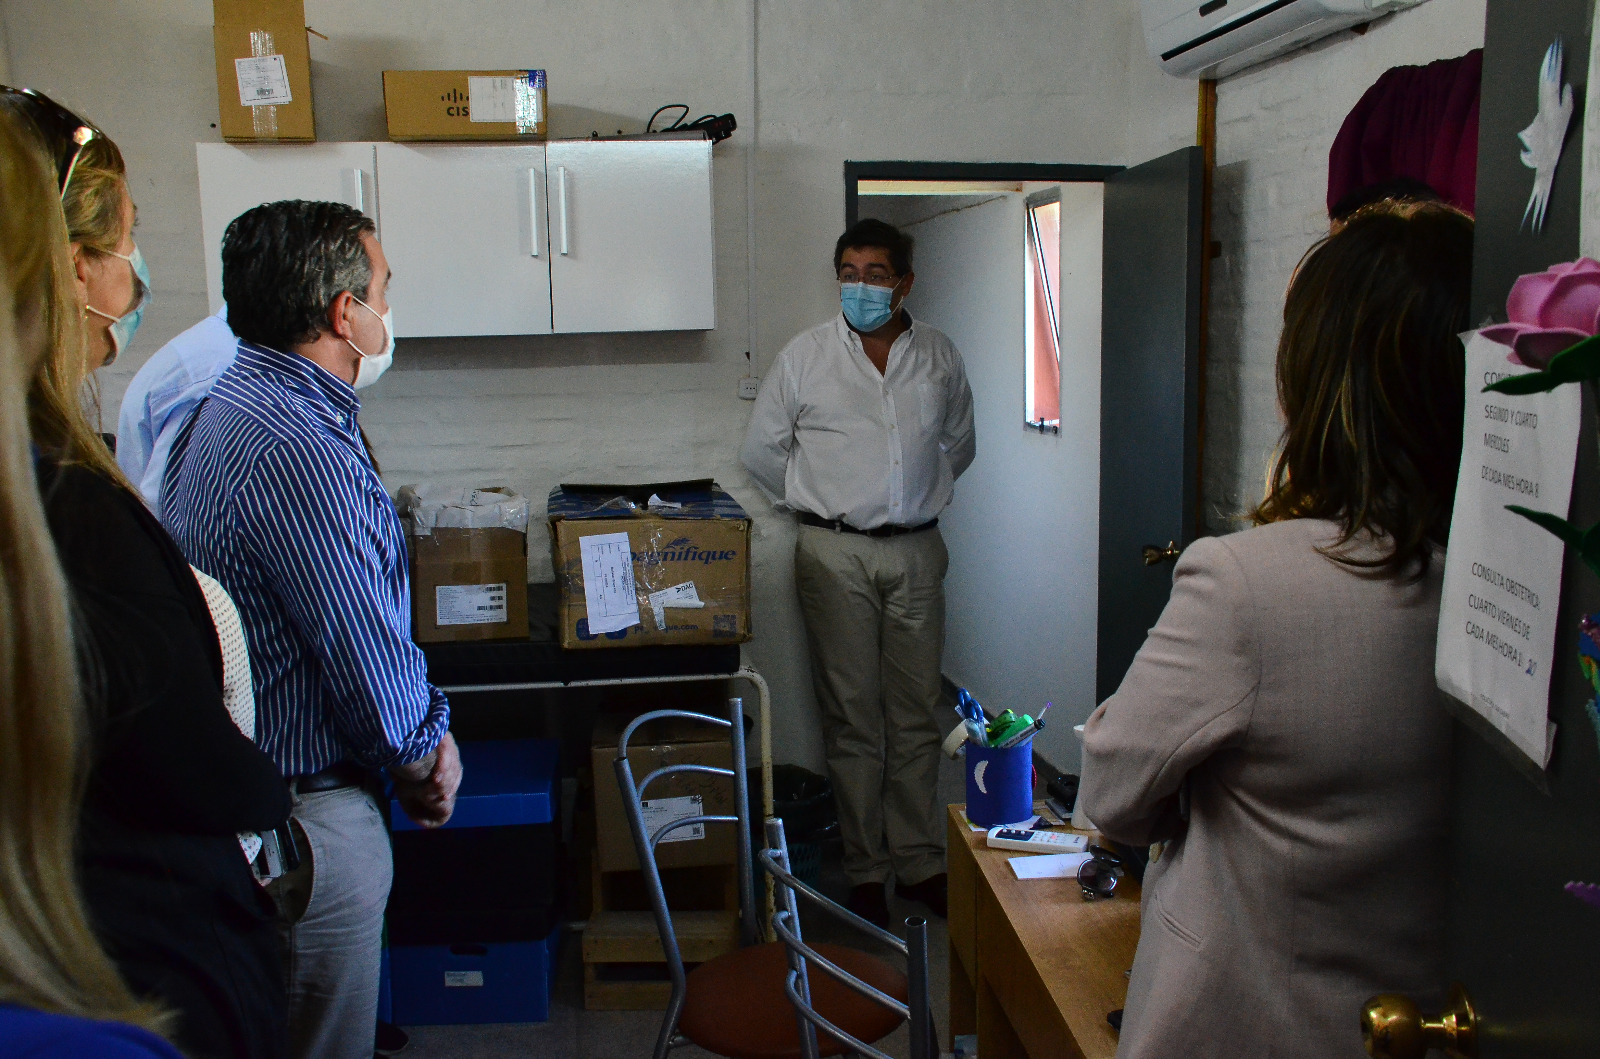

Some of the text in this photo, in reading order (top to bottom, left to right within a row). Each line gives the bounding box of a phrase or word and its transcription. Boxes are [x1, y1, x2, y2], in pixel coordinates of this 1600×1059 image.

[1510, 408, 1515, 424] Y
[1515, 478, 1533, 496] HORA
[1471, 562, 1504, 590] CONSULTA
[1467, 593, 1531, 641] CUARTO VIERNES DE
[1465, 621, 1484, 642] CADA
[1498, 637, 1518, 663] HORA
